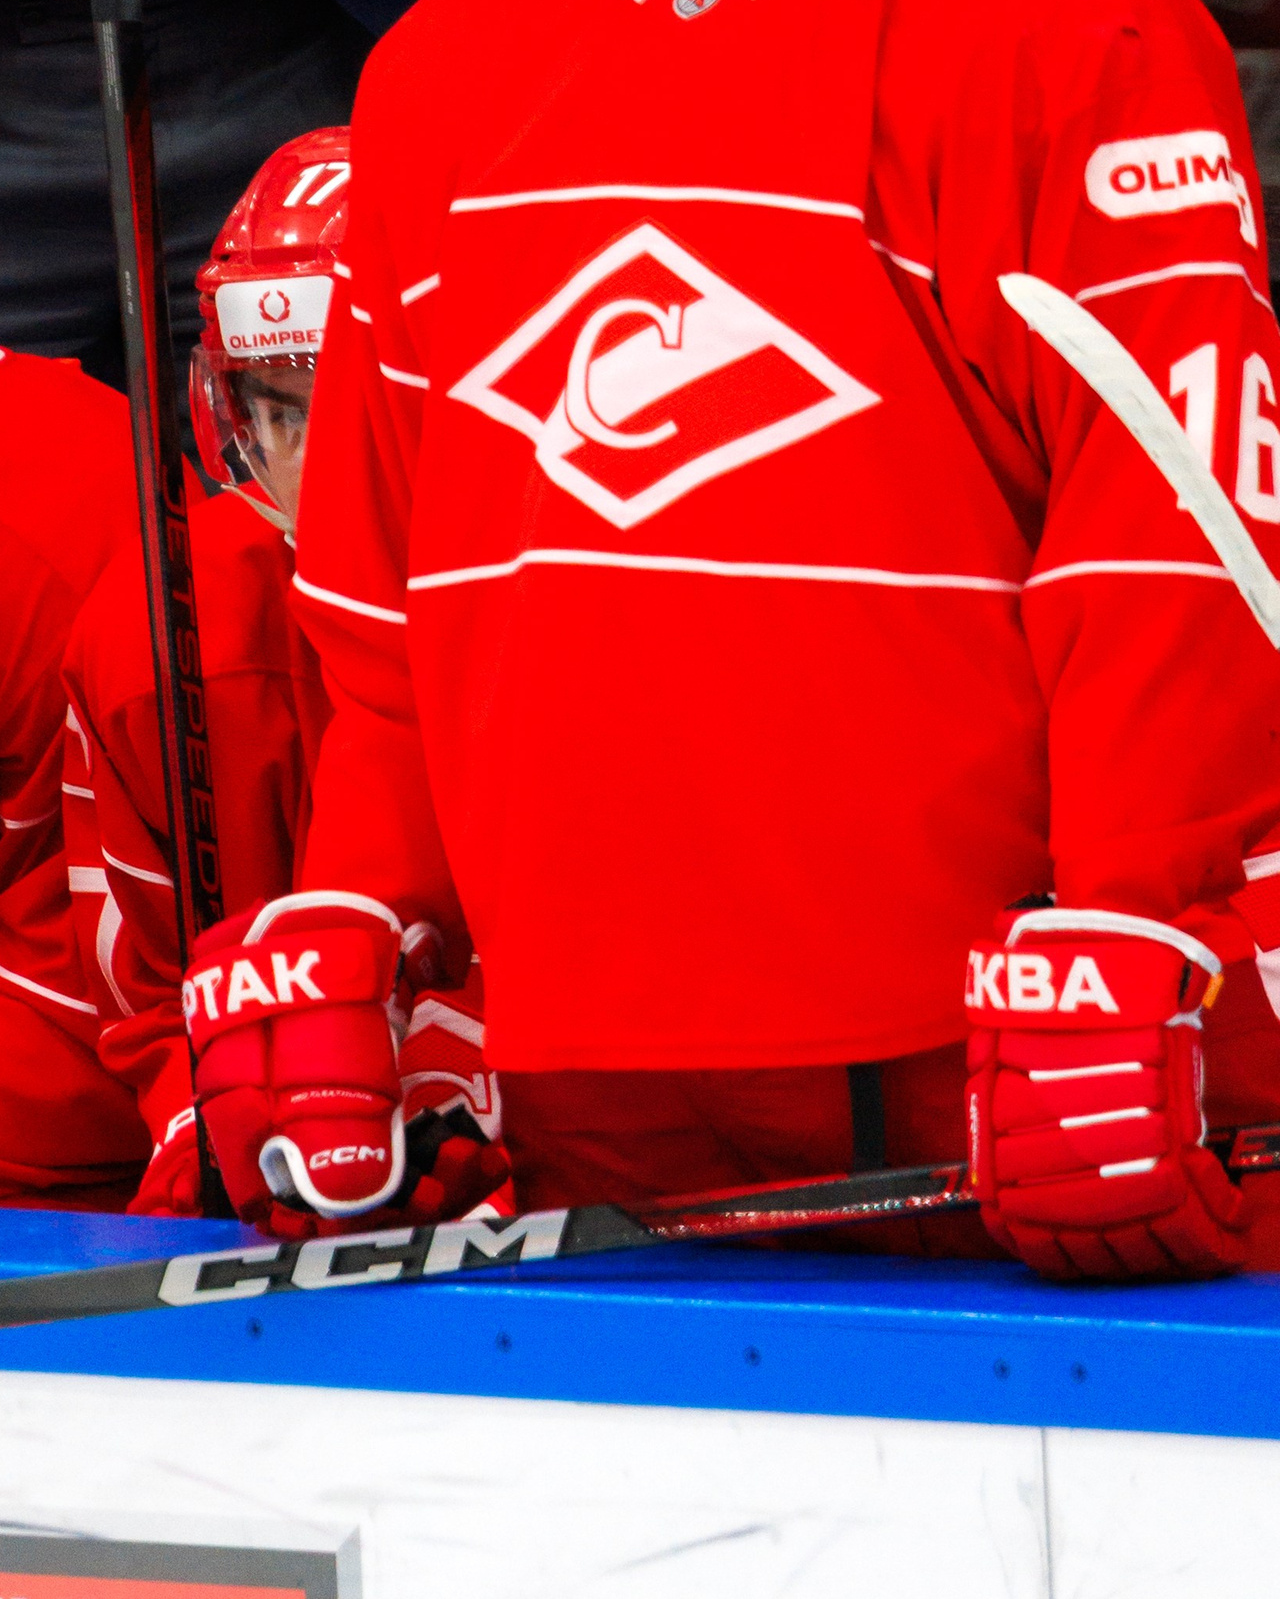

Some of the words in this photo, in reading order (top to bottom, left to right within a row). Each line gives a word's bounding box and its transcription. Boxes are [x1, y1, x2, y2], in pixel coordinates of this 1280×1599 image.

[283, 162, 351, 207] 17
[229, 328, 325, 350] OLIMPBE
[1170, 341, 1280, 525] 16
[309, 1145, 386, 1171] CCM
[157, 1207, 570, 1307] CCM
